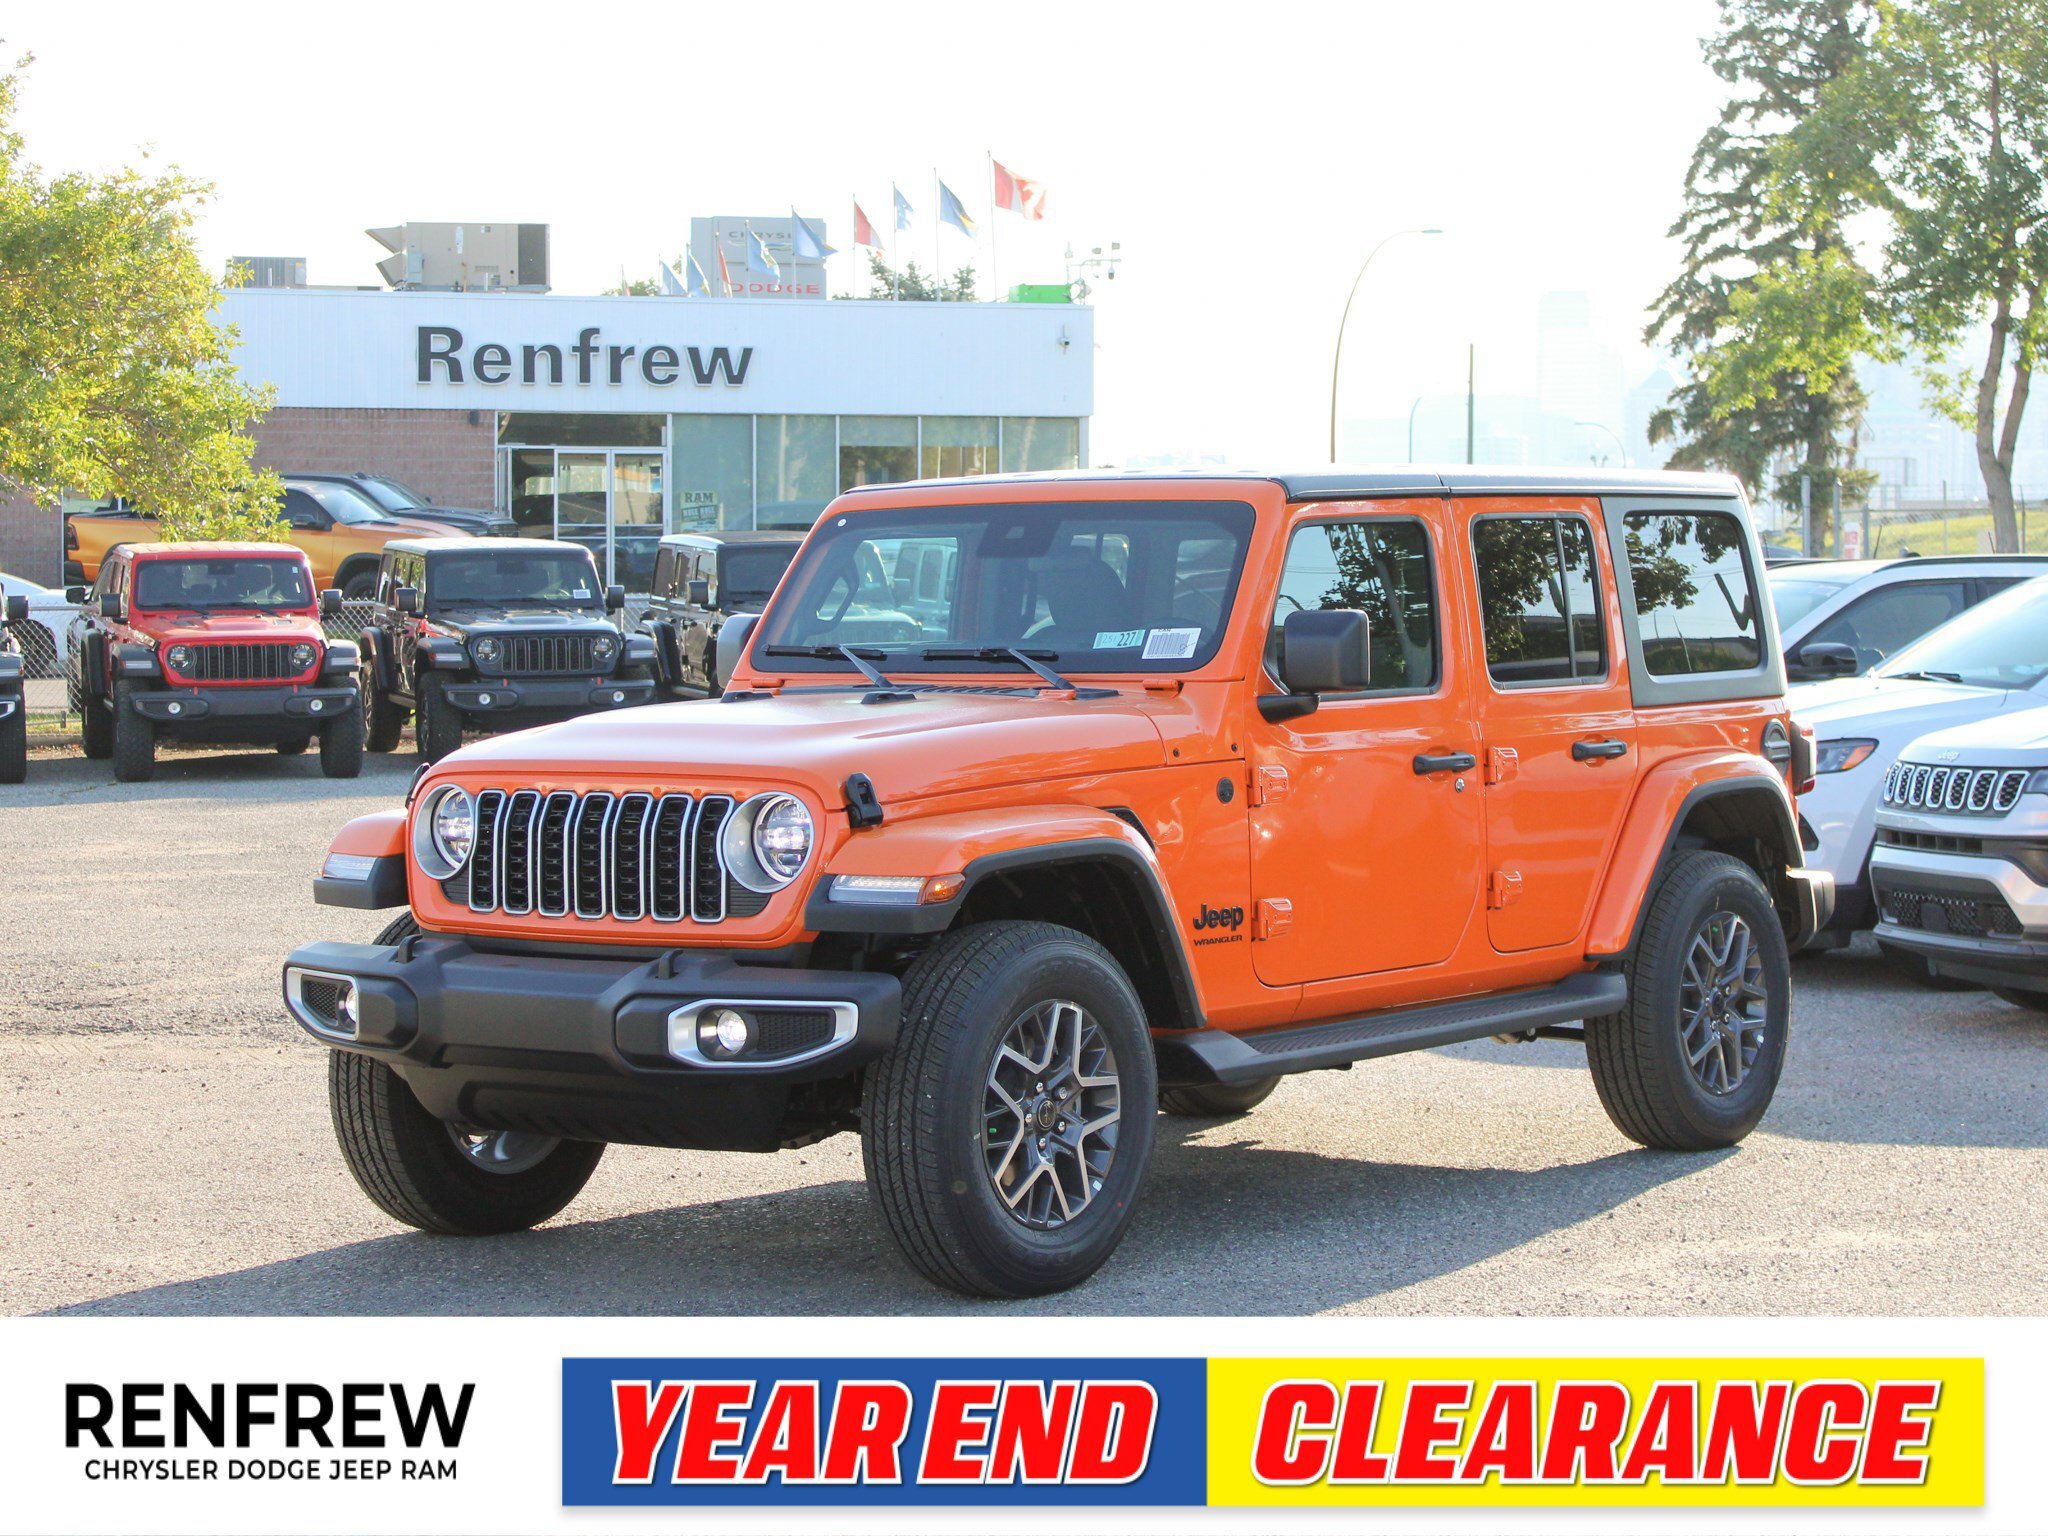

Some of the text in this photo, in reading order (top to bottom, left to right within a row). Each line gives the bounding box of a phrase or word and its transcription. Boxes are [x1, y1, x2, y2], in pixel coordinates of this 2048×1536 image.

[416, 325, 754, 387] Renfrew
[685, 493, 713, 503] RAM
[1117, 631, 1137, 647] 227
[1193, 902, 1244, 931] Jeep
[1193, 934, 1243, 946] WRANGLER
